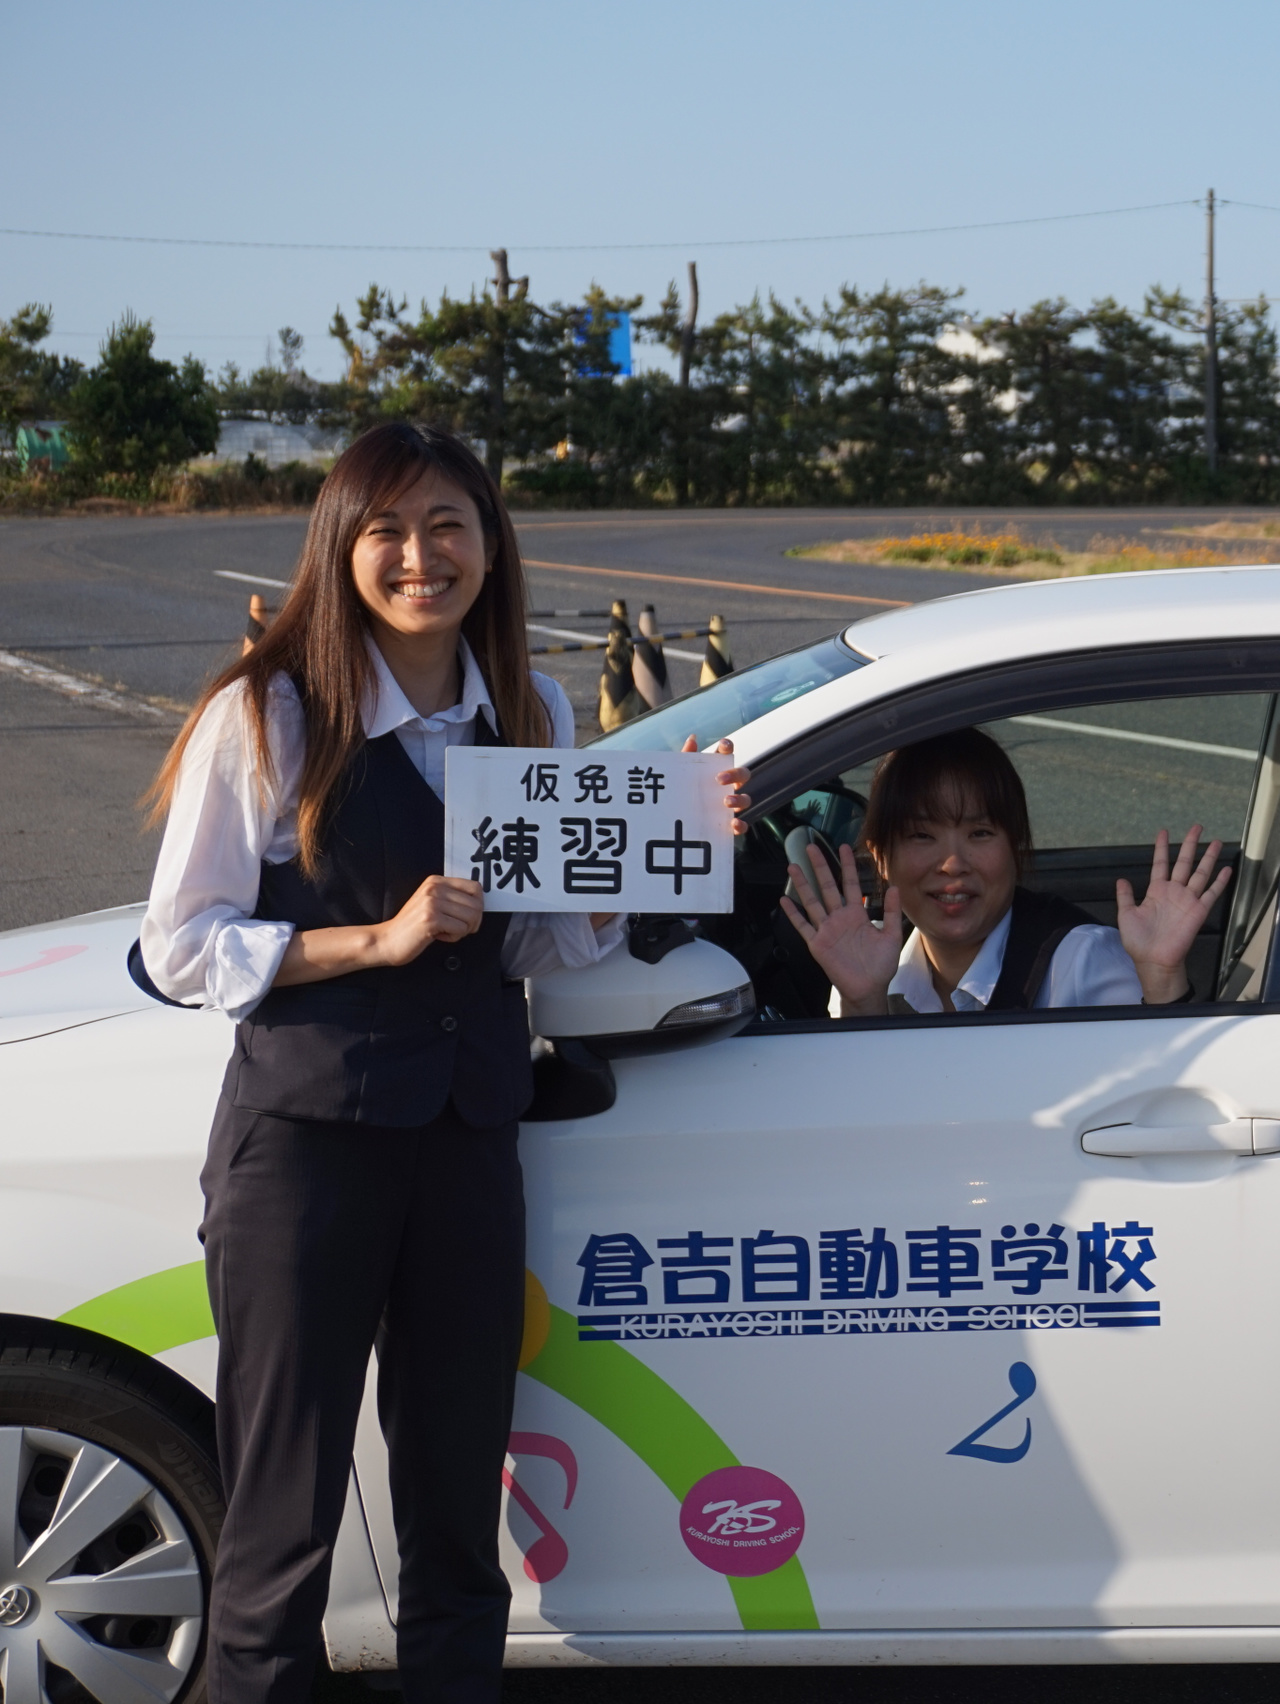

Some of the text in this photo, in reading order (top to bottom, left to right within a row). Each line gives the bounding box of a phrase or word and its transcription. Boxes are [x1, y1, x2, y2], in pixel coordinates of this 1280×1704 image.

[520, 763, 666, 805] 仮免許
[470, 816, 712, 896] 練習中
[576, 1220, 1158, 1307] 倉吉自動車学校
[620, 1304, 1099, 1339] KURAYOSHI DRIVING SCHOOL
[685, 1525, 801, 1548] KURAYOSHI DRIVING SCHOOL
